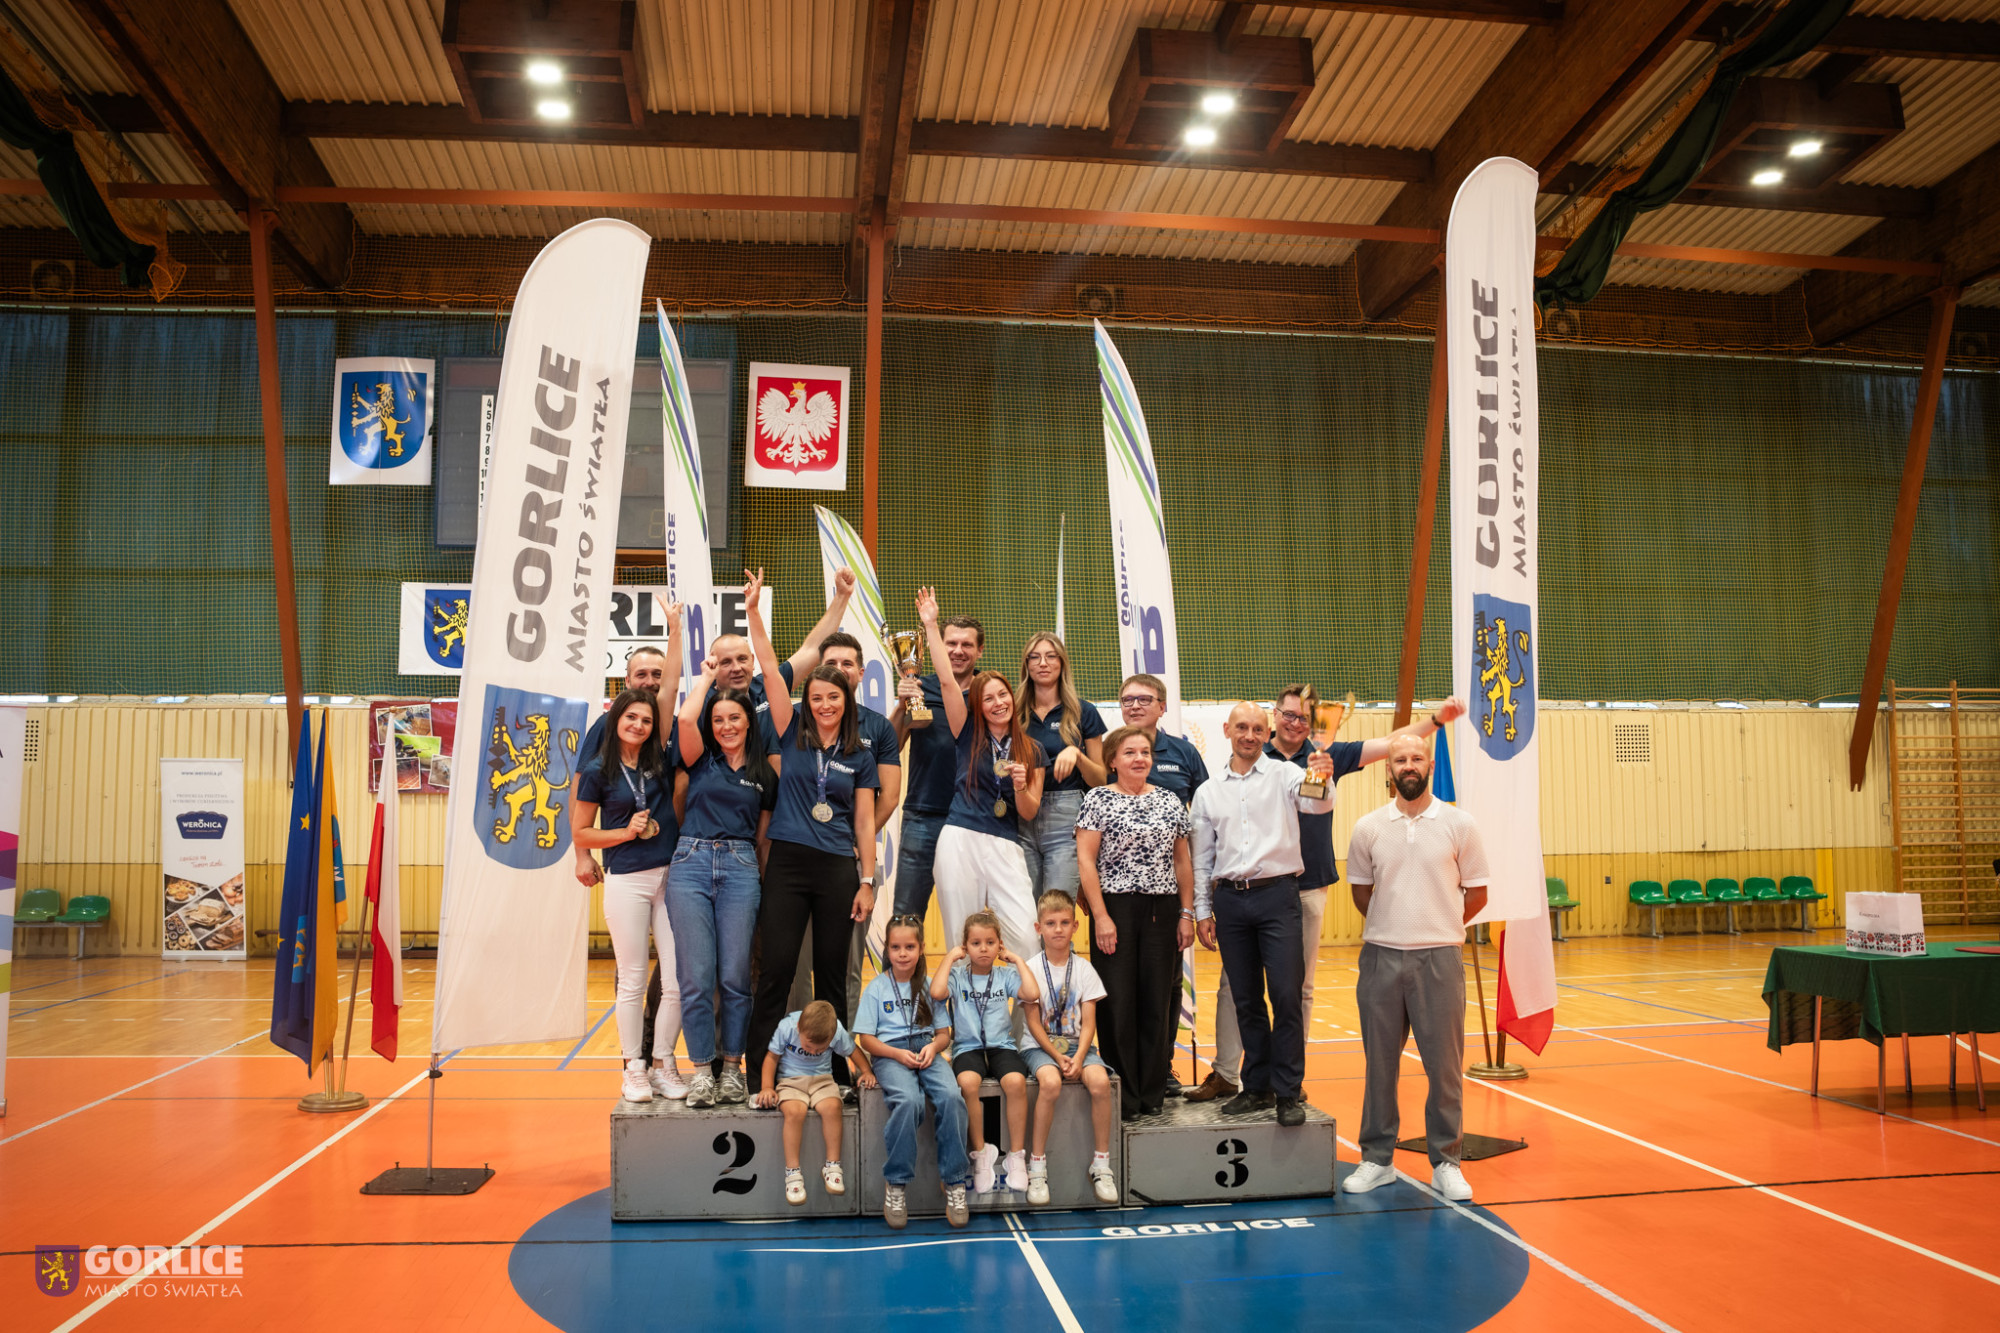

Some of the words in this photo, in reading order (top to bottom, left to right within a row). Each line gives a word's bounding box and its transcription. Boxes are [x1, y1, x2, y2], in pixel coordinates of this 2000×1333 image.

[486, 398, 492, 408] 4
[486, 410, 492, 420] 5
[485, 422, 491, 432] 6
[485, 434, 491, 443] 7
[484, 446, 490, 455] 8
[579, 377, 610, 520] ŚWIATŁA
[506, 344, 581, 662] GORLICE
[1512, 447, 1527, 578] MIASTO
[565, 531, 594, 673] MIASTO
[712, 1130, 757, 1195] 2
[1215, 1138, 1249, 1188] 3
[1102, 1217, 1315, 1237] GORLICE
